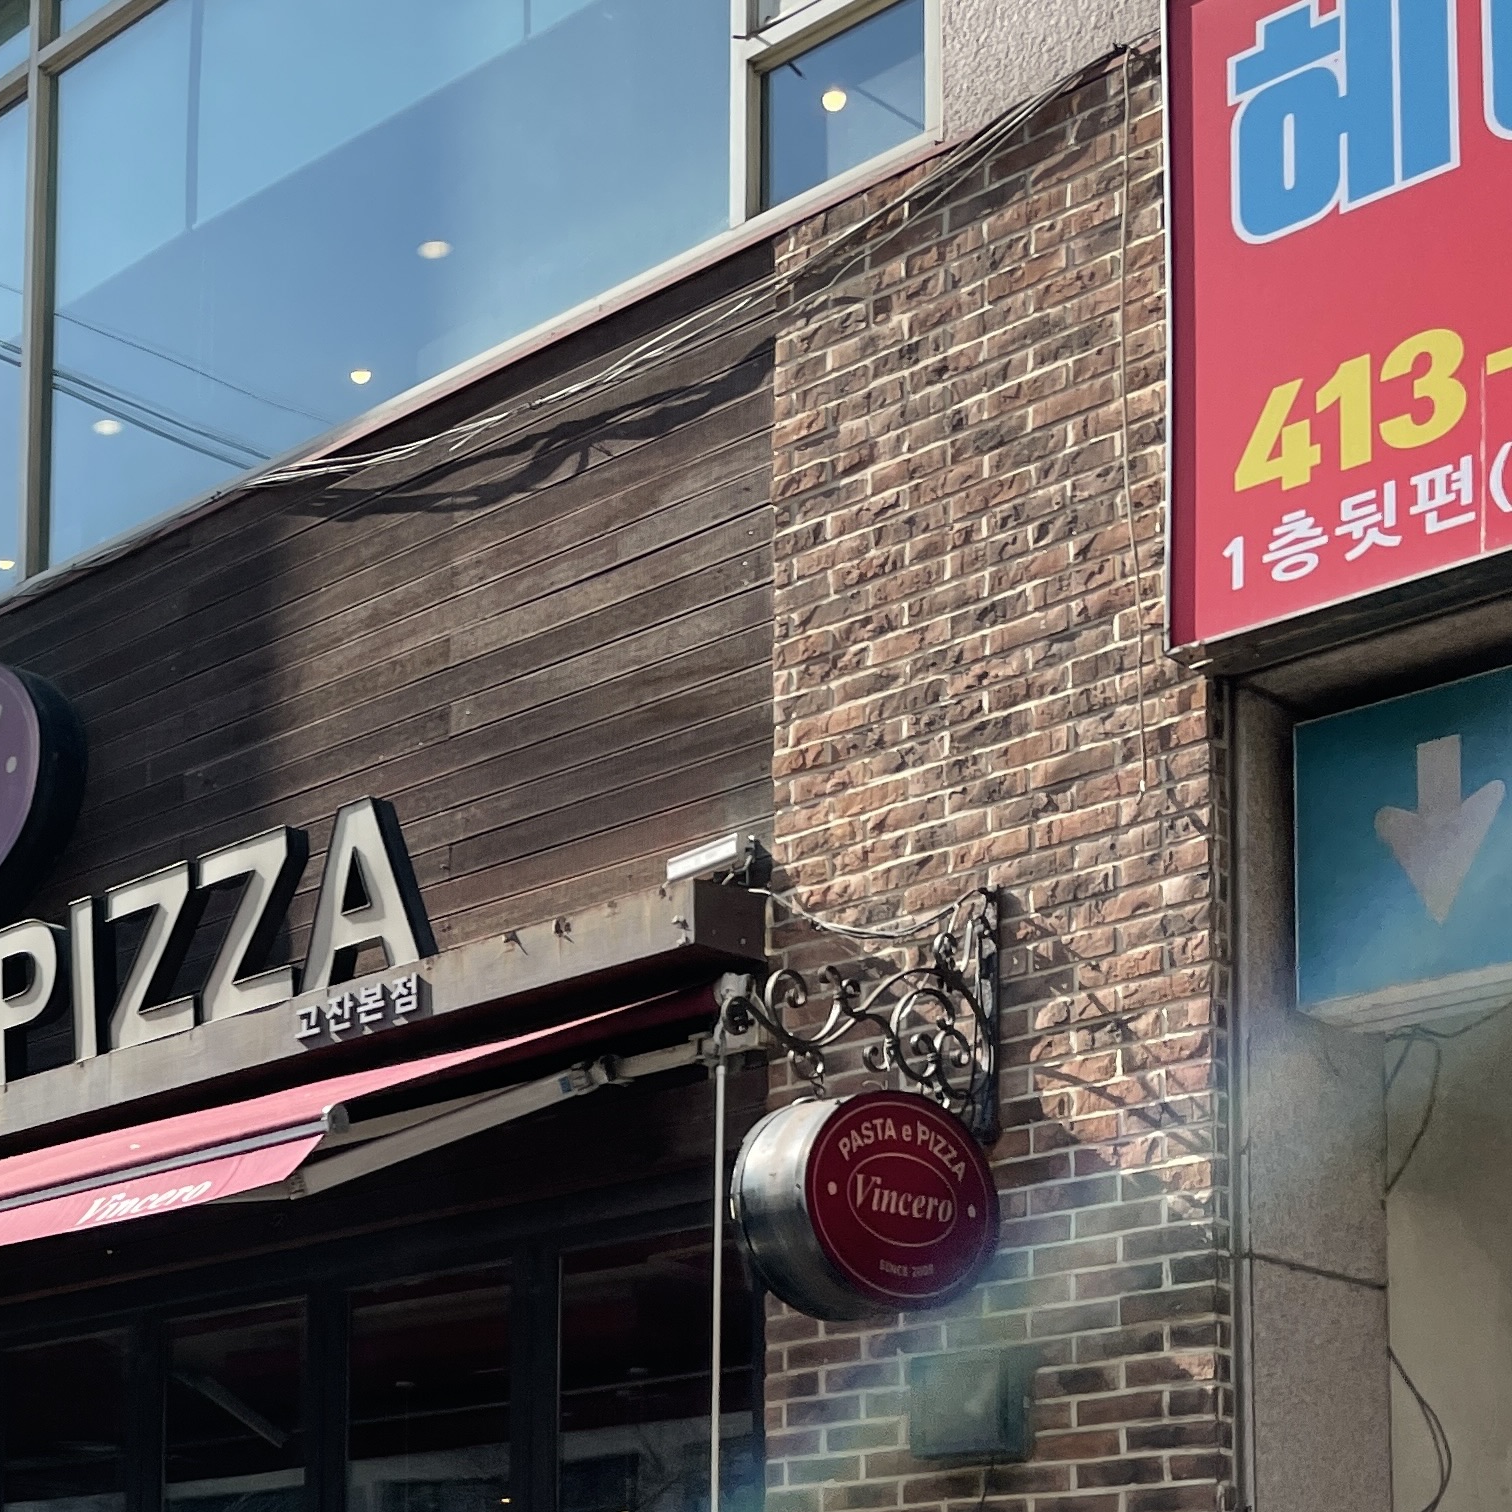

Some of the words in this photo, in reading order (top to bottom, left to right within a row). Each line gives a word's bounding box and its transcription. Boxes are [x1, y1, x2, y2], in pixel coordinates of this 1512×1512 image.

[1226, 0, 1512, 246] 헤
[294, 971, 419, 1040] 고잔본점
[838, 1117, 897, 1162] PASTA
[901, 1123, 913, 1143] e
[916, 1119, 967, 1183] PIZZA
[74, 1180, 213, 1227] Vincero
[854, 1172, 955, 1224] Vincero
